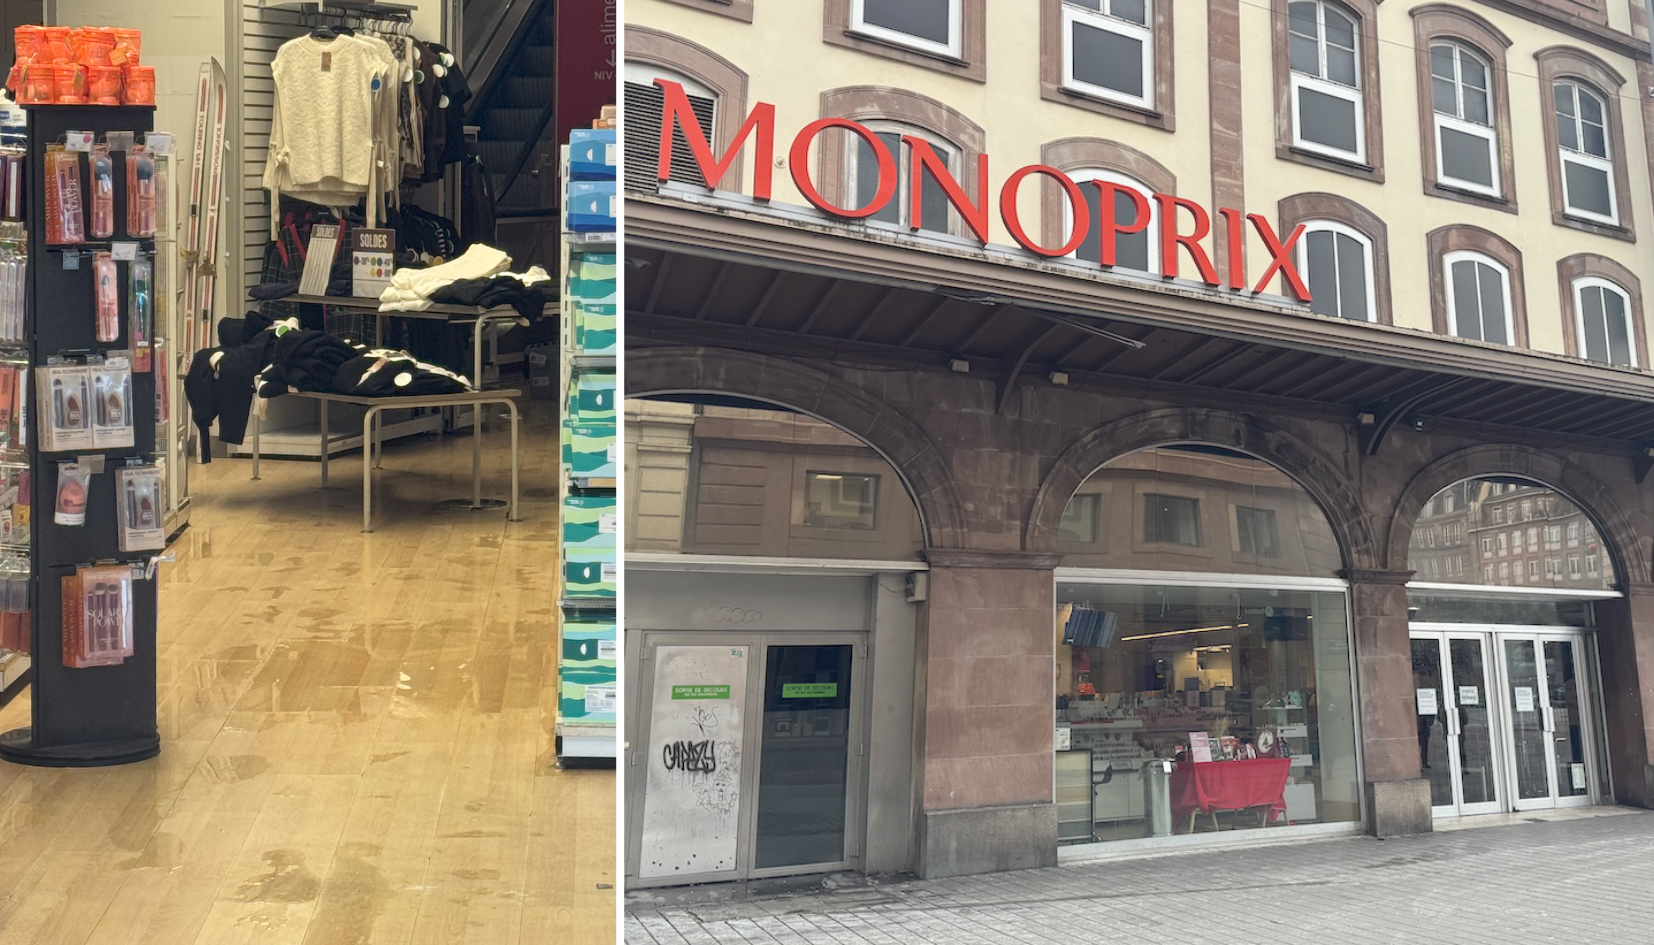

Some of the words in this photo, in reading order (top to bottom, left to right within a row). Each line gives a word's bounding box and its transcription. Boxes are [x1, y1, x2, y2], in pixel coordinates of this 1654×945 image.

[594, 71, 613, 80] NIV
[196, 114, 205, 150] TOURING
[652, 77, 1311, 303] MONOPRIX
[316, 227, 334, 237] SOLDES
[360, 233, 387, 249] SOLDES
